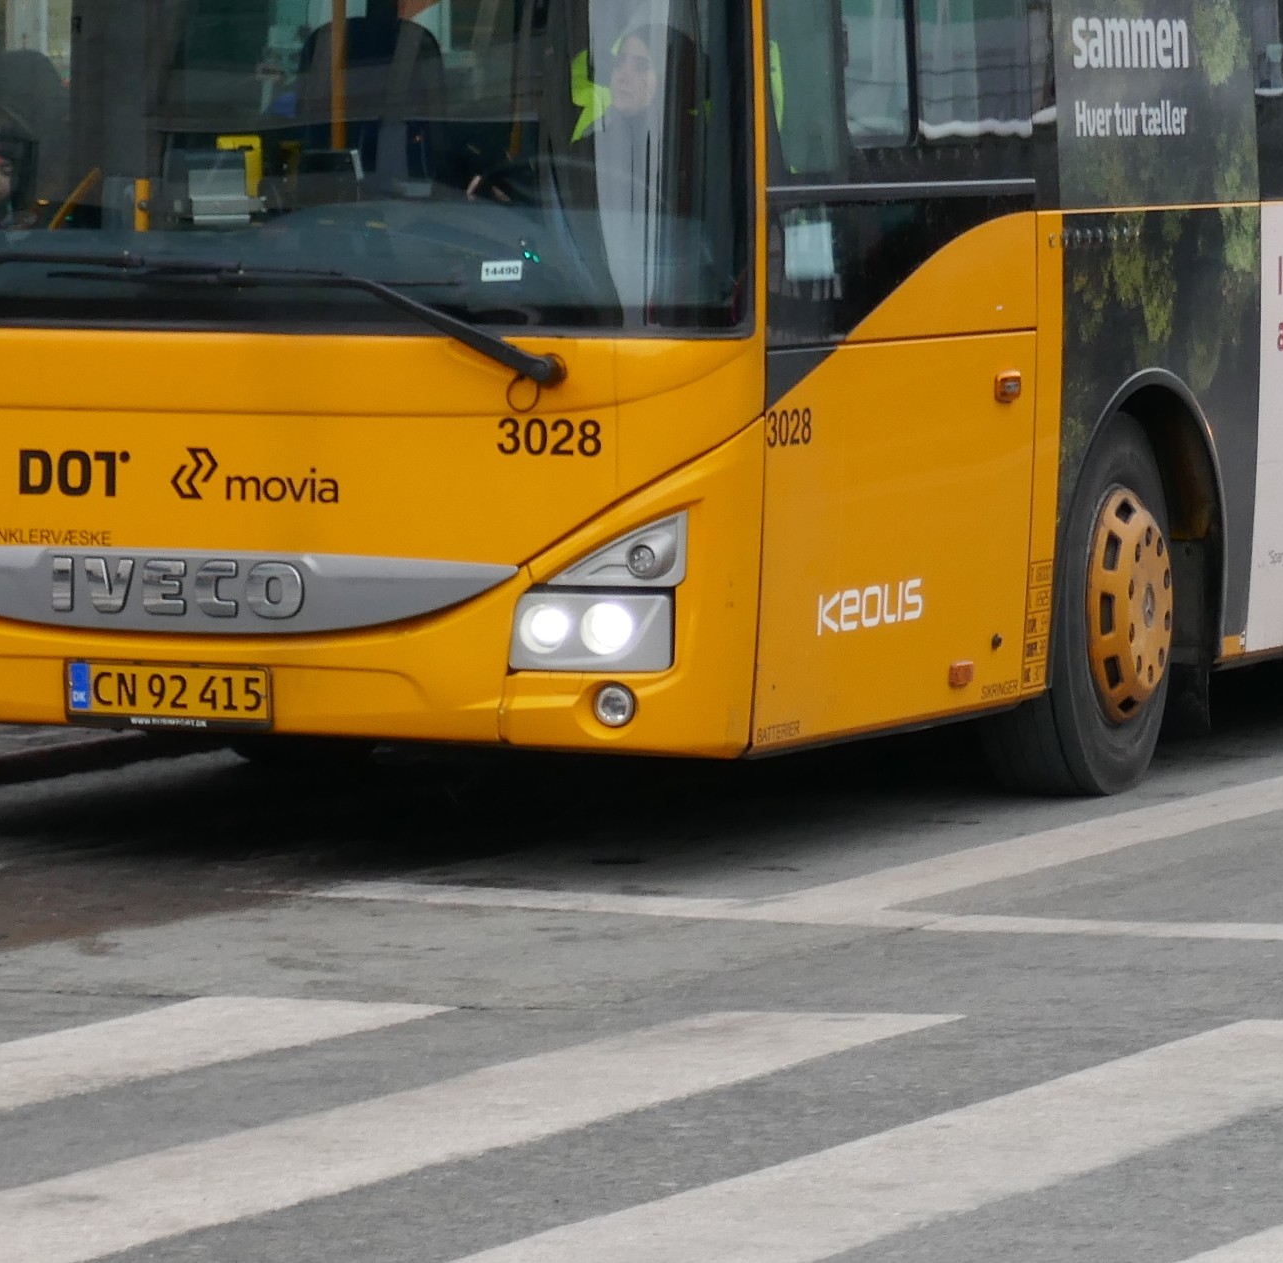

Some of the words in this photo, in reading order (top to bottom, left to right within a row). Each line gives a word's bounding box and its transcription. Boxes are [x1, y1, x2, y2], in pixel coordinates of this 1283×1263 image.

[1072, 16, 1189, 70] sammen
[1075, 100, 1113, 136] Hver
[1114, 102, 1138, 136] tur
[1140, 99, 1188, 136] tæller
[1278, 255, 1283, 295] I
[497, 417, 602, 457] 3028
[767, 407, 812, 448] 3028
[19, 448, 130, 498] DOT
[225, 467, 339, 504] movia
[50, 555, 305, 620] IVECO
[93, 671, 137, 707] CN
[148, 673, 188, 709] 92
[199, 675, 262, 712] 415
